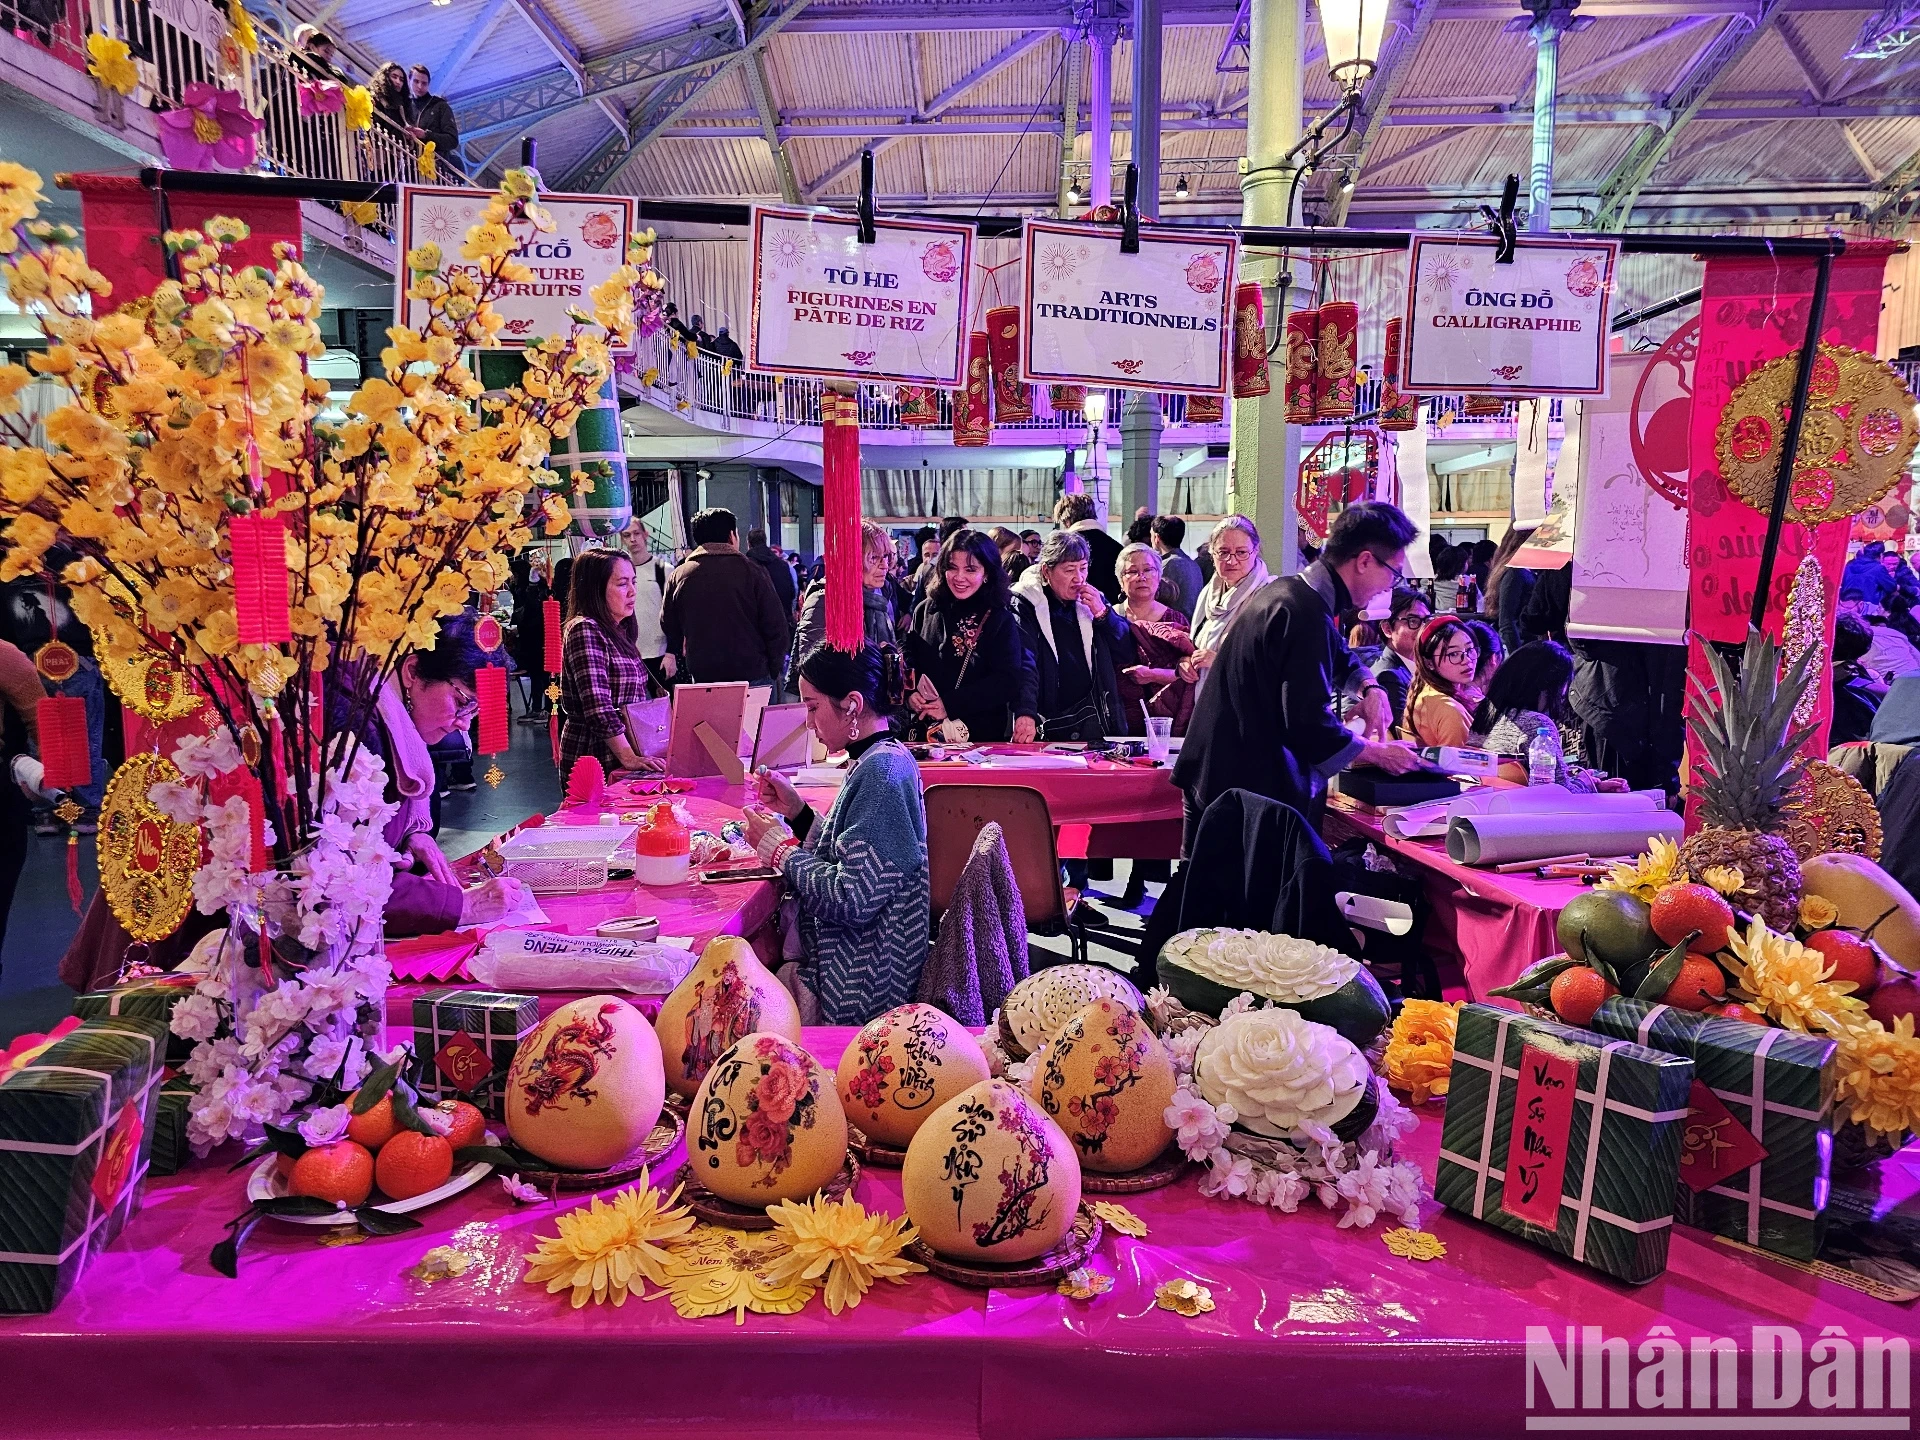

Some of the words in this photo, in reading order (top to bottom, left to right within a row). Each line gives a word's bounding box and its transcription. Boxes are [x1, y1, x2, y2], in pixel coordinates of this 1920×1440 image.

[536, 239, 572, 259] CỖ
[449, 264, 585, 281] SCTURE
[862, 271, 899, 290] HE
[787, 290, 904, 313] FIGURINES
[907, 300, 938, 316] EN
[1099, 290, 1158, 309] ARTS
[1465, 288, 1516, 308] ÔNG
[1520, 289, 1554, 309] ĐỒ
[793, 306, 851, 326] PÂTE
[856, 313, 886, 328] DE
[889, 316, 925, 332] RIZ
[1036, 303, 1217, 332] TRADITIONNELS
[1432, 315, 1582, 332] CALLIGRAPHIE
[523, 938, 569, 954] HENG
[1533, 1059, 1565, 1091] Vạn
[1527, 1096, 1547, 1123] Sự
